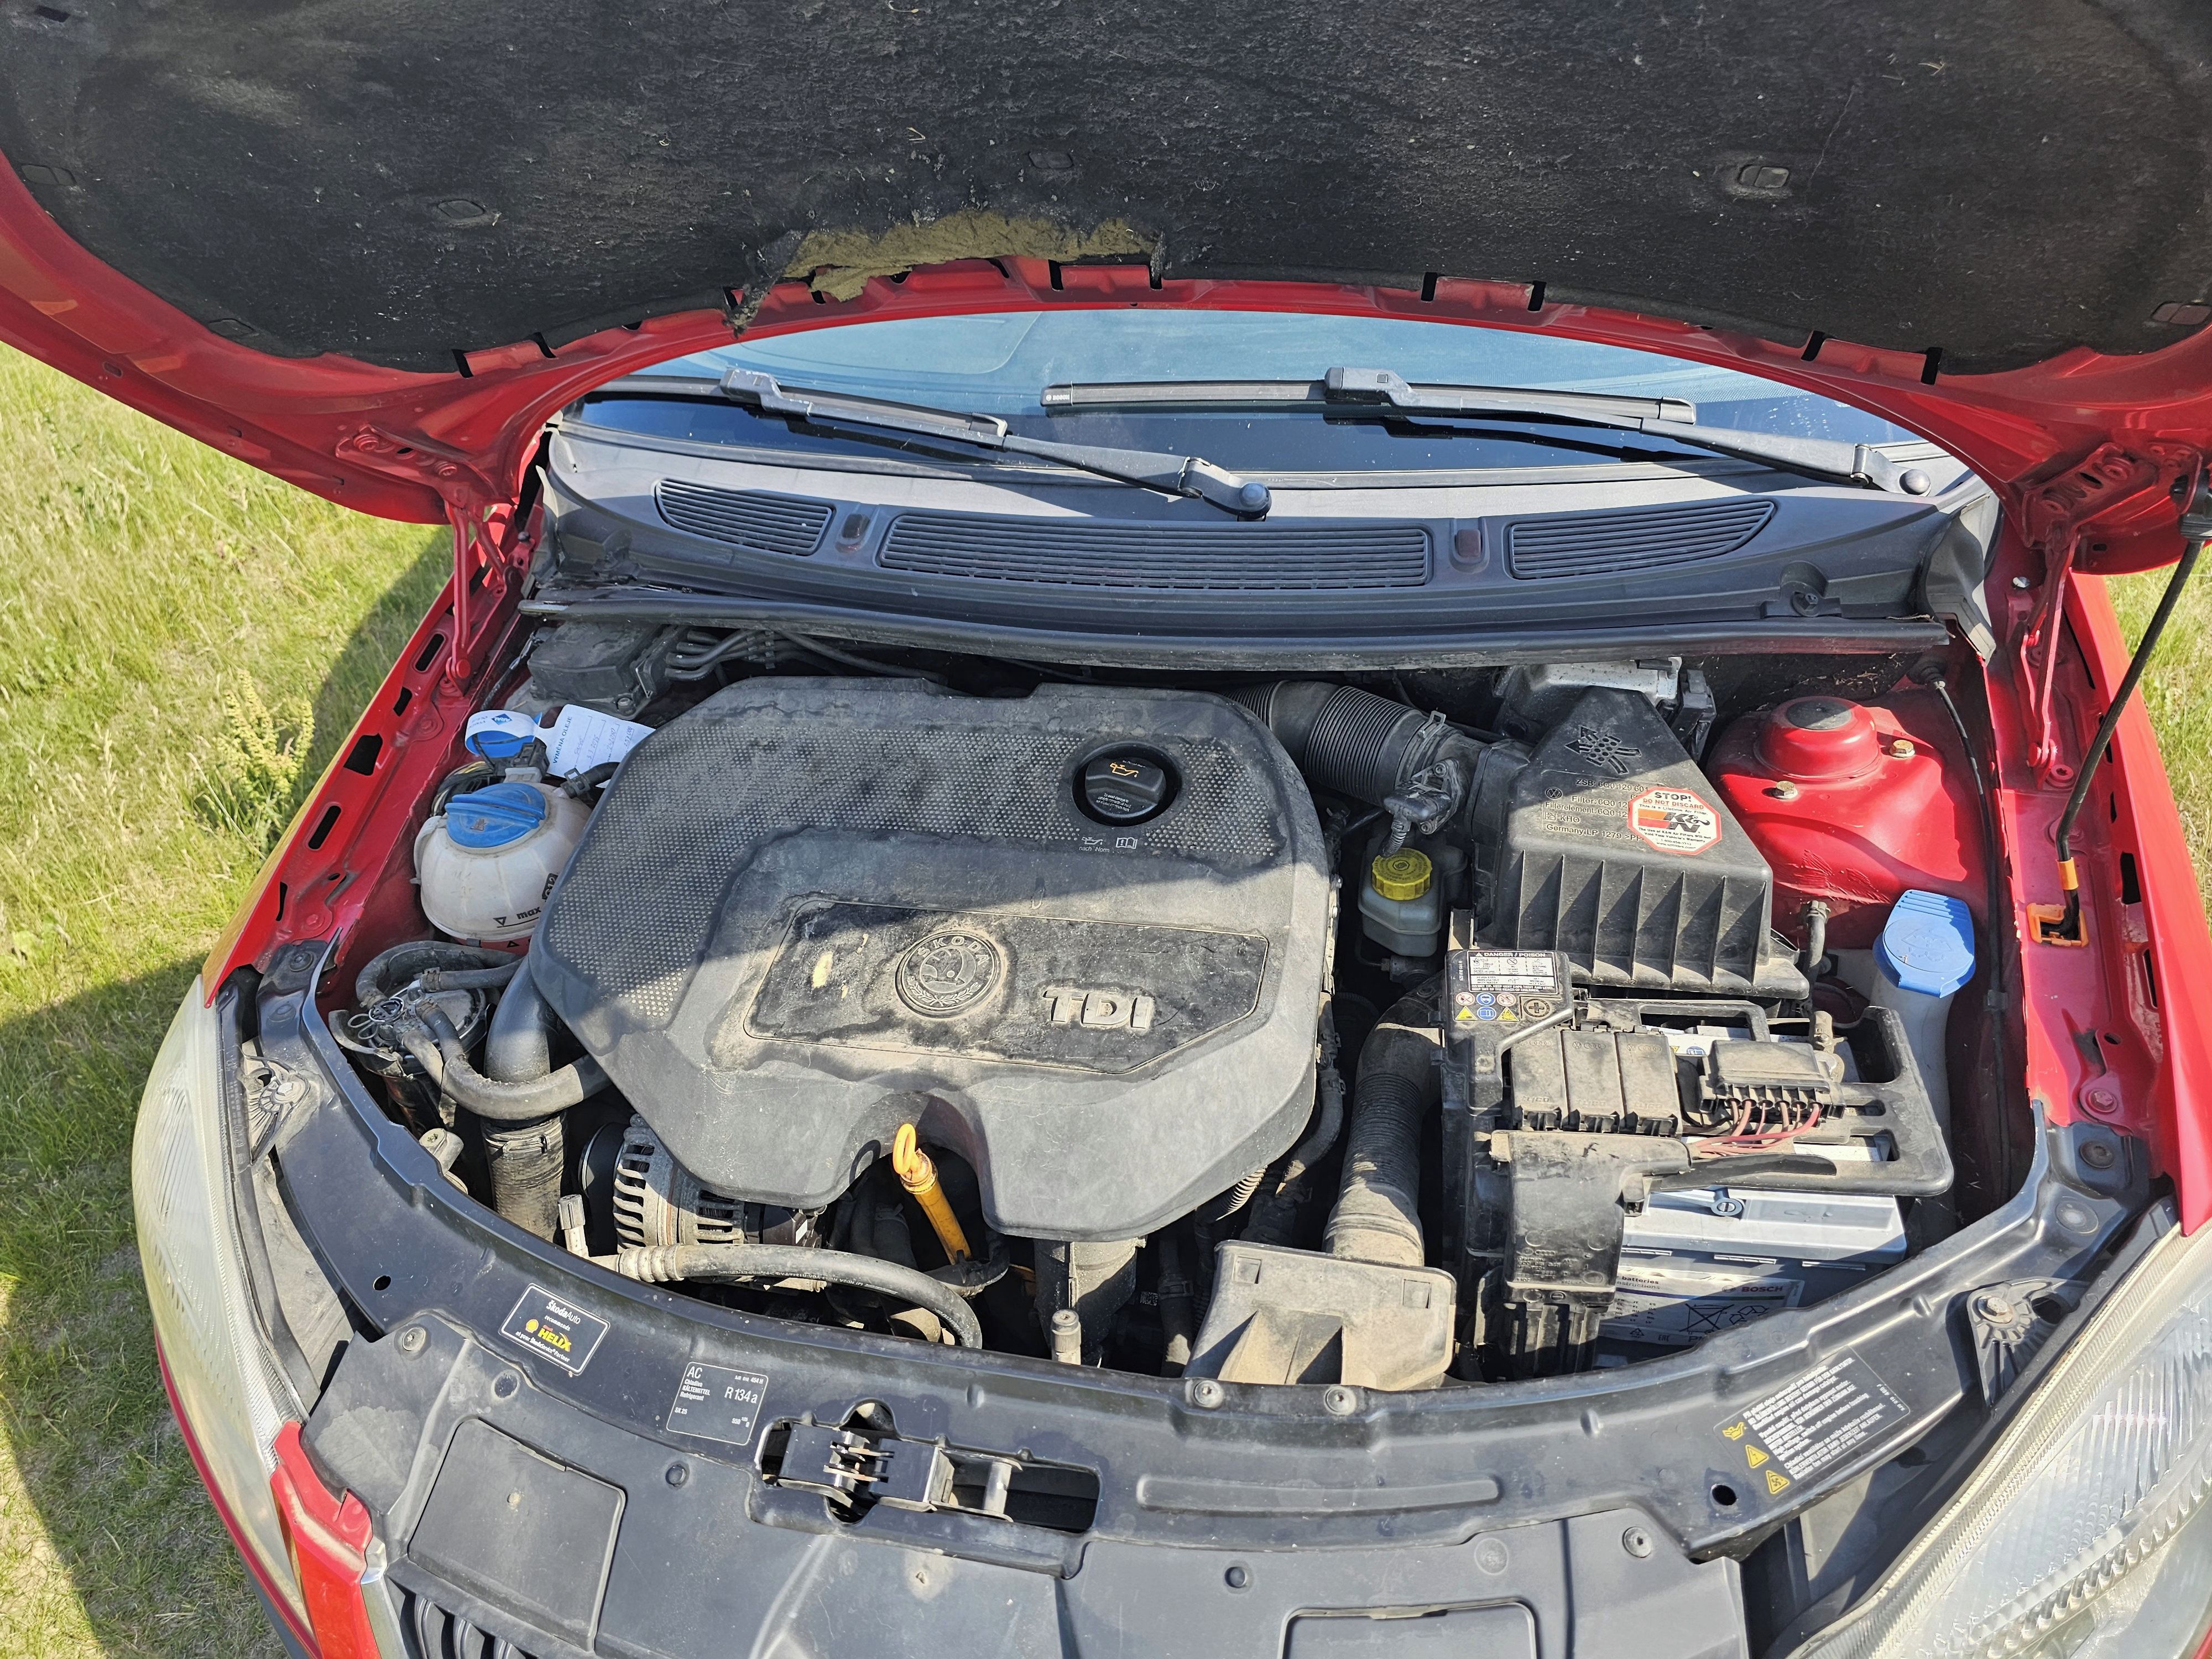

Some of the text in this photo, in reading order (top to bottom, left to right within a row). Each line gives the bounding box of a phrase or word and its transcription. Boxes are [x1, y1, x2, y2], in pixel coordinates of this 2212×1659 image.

[561, 716, 572, 737] OLEJE
[1655, 792, 1691, 802] STOP!
[1546, 802, 1597, 813] Filterelement:
[1547, 824, 1584, 836] Germany
[517, 907, 541, 920] max
[1042, 990, 1152, 1029] TDI
[1617, 1281, 1660, 1290] nstructions
[546, 1300, 581, 1324] ŠkodaAuto
[544, 1315, 571, 1331] recommends
[538, 1328, 572, 1352] HELIX
[554, 1350, 570, 1363] Partner
[687, 1366, 703, 1379] AC
[682, 1385, 710, 1395] KÄLTEMITTEL
